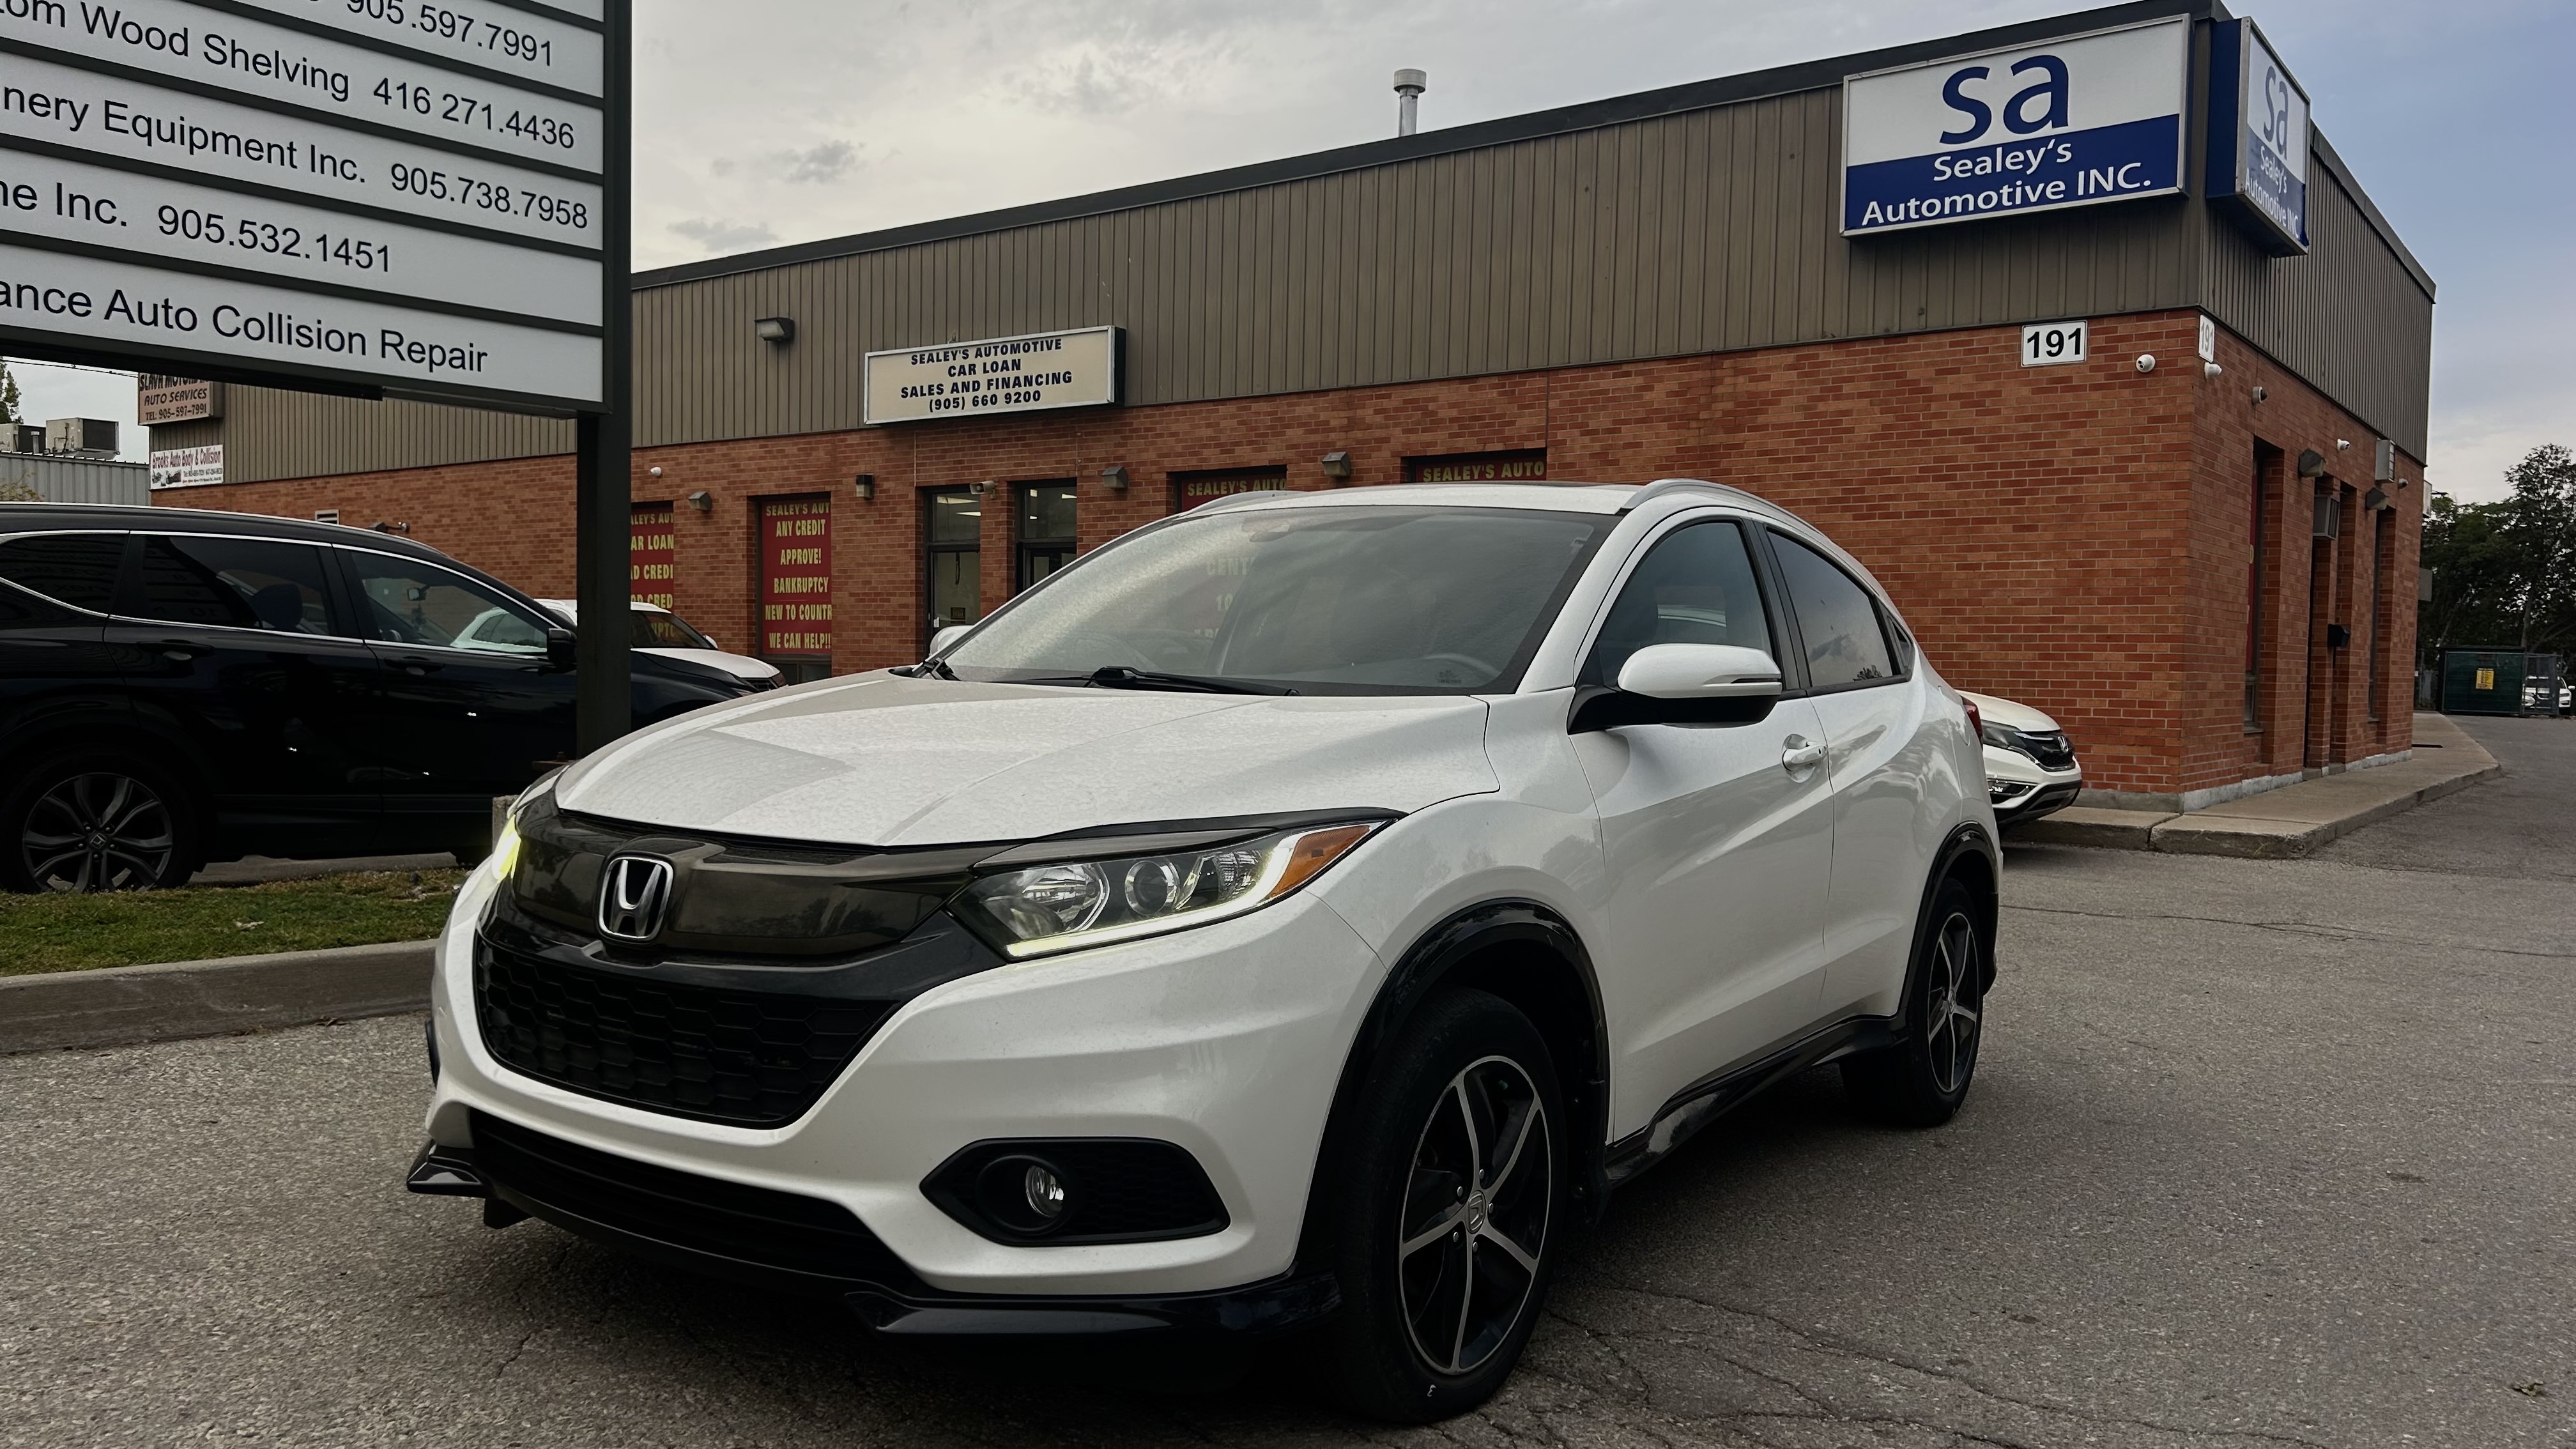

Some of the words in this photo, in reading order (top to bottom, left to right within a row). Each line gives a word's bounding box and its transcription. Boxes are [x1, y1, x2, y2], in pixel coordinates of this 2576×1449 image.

[0, 0, 66, 28] om
[81, 1, 188, 57] Wood
[203, 33, 349, 102] Shelving
[373, 77, 431, 114] 416
[442, 93, 574, 149] 271.4436
[4, 86, 89, 132] nery
[103, 100, 298, 169] Equipment
[310, 144, 365, 183] Inc.
[390, 163, 588, 229] 905.738.7958
[1933, 139, 2072, 181] Sealey's
[1861, 178, 2066, 226] Automotive
[2076, 162, 2151, 196] INC.
[2244, 167, 2287, 227] Automotive
[56, 181, 127, 227] Inc.
[158, 204, 388, 272] 905.532.1451
[103, 289, 197, 332] Auto
[212, 304, 366, 356] Collision
[381, 328, 488, 372] Repair
[2201, 321, 2213, 355] 191
[910, 348, 969, 365] SEALEY'S
[975, 339, 1062, 358] AUTOMOTIVE
[2027, 326, 2082, 358] 191
[947, 364, 977, 378] CAR
[983, 358, 1022, 374] LOAN
[901, 383, 944, 399] SALES
[950, 380, 981, 395] AND
[986, 371, 1073, 391] FINANCING
[144, 393, 167, 406] AUTO
[169, 388, 208, 402] SERVICES
[929, 395, 965, 412] (905)
[972, 392, 998, 408] 660
[1004, 390, 1041, 404] 9200
[159, 403, 207, 420] 905-597-7991
[1423, 463, 1494, 482] SEALEY'S
[1500, 460, 1545, 478] AUTO
[1188, 480, 1246, 496] SEALEY'S
[766, 503, 808, 517] SEALEY'S
[811, 502, 830, 514] AUT
[776, 521, 793, 537] ANY
[795, 519, 826, 536] CREDIT
[648, 534, 675, 550] LOAN
[780, 548, 822, 565] APPROVE!
[643, 564, 673, 579] CREDI
[773, 576, 829, 594] BANKRUPTCY
[765, 604, 783, 620] NEW
[786, 604, 796, 620] TO
[799, 604, 832, 620] COUNTR
[769, 632, 781, 648] WE
[784, 632, 801, 648] CAN
[804, 632, 831, 649] HELP!!
